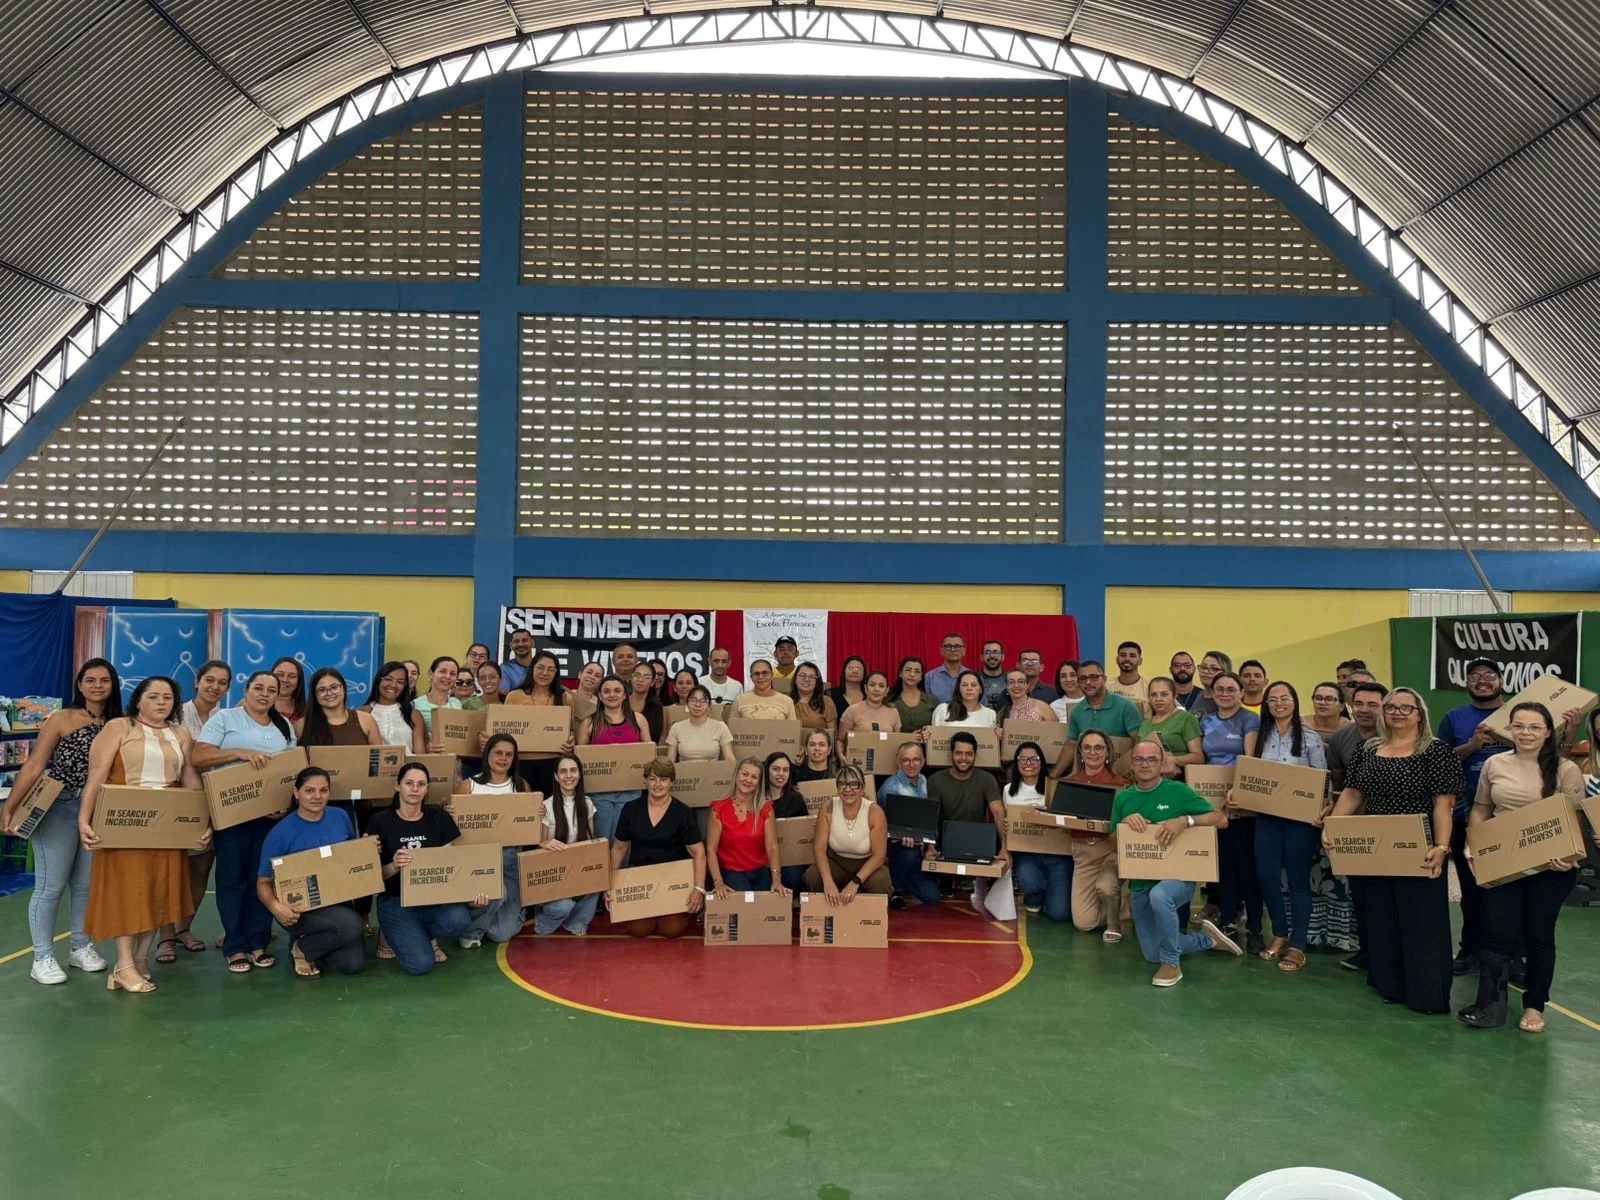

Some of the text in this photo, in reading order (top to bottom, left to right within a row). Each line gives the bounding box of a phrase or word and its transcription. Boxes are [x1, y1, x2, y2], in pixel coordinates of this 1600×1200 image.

[506, 608, 705, 641] SENTIMENTOS
[1453, 621, 1549, 650] CULTURA
[588, 761, 609, 769] SEARCH
[583, 768, 612, 776] NCREDIBLE
[1248, 776, 1270, 785] SEARCH
[1271, 780, 1280, 788] OF
[220, 779, 264, 799] IN SEARCH OF
[1240, 783, 1273, 795] INCREDIBLE
[1293, 789, 1315, 799] ASUS
[221, 789, 261, 807] INCREDIBLE
[107, 809, 115, 817] IN
[117, 810, 146, 818] SEARCH
[458, 814, 465, 822] IN
[466, 813, 489, 821] SEARCH
[105, 818, 149, 827] INCREDIBLE
[457, 821, 493, 830] INCREDIBLE
[1520, 817, 1561, 837] INCREDIBLE
[1334, 837, 1376, 845] IN SEARCH OF
[1518, 826, 1563, 848] IN SEARCH OF
[1133, 843, 1159, 851] SEARCH
[1335, 846, 1372, 854] INCREDIBLE
[1478, 842, 1501, 856] ASUS
[1126, 851, 1163, 860] INCREDIBLE
[1184, 849, 1209, 857] ASUS
[349, 863, 374, 874] ASUS
[410, 866, 455, 877] IN SEARCH OF
[471, 868, 495, 876] ASUS
[534, 868, 558, 879] SEARCH
[559, 865, 567, 873] OF
[581, 863, 603, 872] ASUS
[410, 875, 449, 885] INCREDIBLE
[527, 875, 563, 888] INCREDIBLE
[623, 885, 646, 895] SEARCH
[646, 883, 654, 891] OF
[668, 882, 689, 892] ASUS
[616, 892, 650, 903] INCREDIBLE
